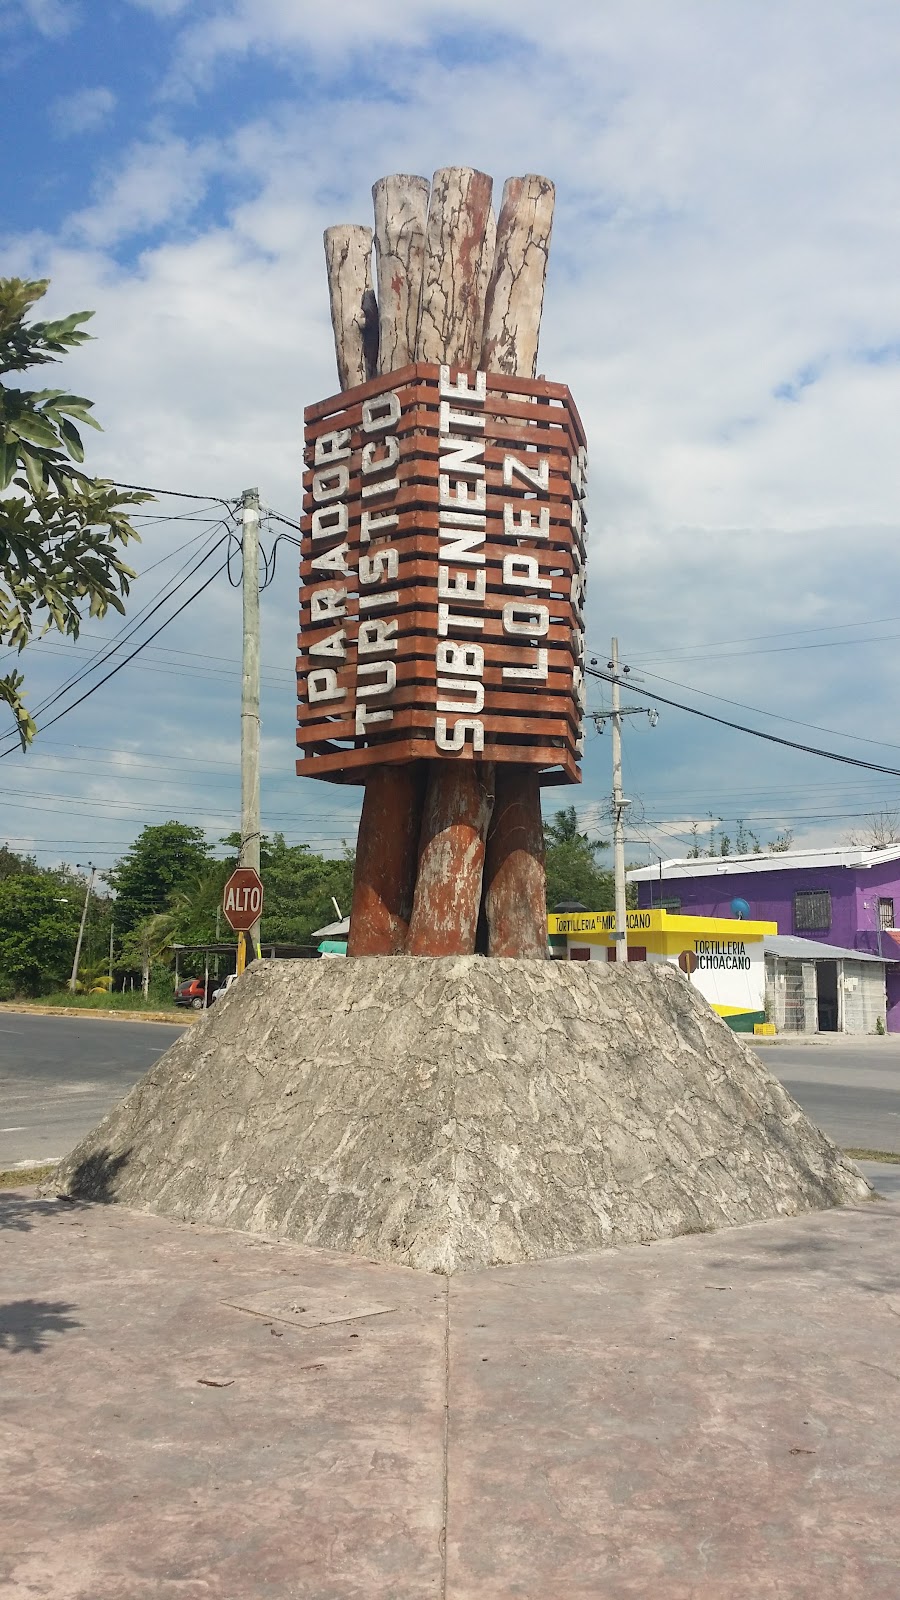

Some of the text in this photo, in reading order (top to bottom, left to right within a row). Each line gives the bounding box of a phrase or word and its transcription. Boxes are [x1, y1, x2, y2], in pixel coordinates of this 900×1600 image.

[308, 428, 352, 704] PARADOR
[355, 391, 401, 736] TURISTICO
[435, 364, 487, 753] SUBTENIENTE
[502, 453, 552, 682] LOPEZ
[225, 886, 261, 912] ALTO
[555, 917, 596, 932] TORTILLERIA
[602, 913, 651, 930] MICACANO
[693, 939, 746, 956] TORTILLERIA
[696, 955, 751, 970] ICHOACANO
